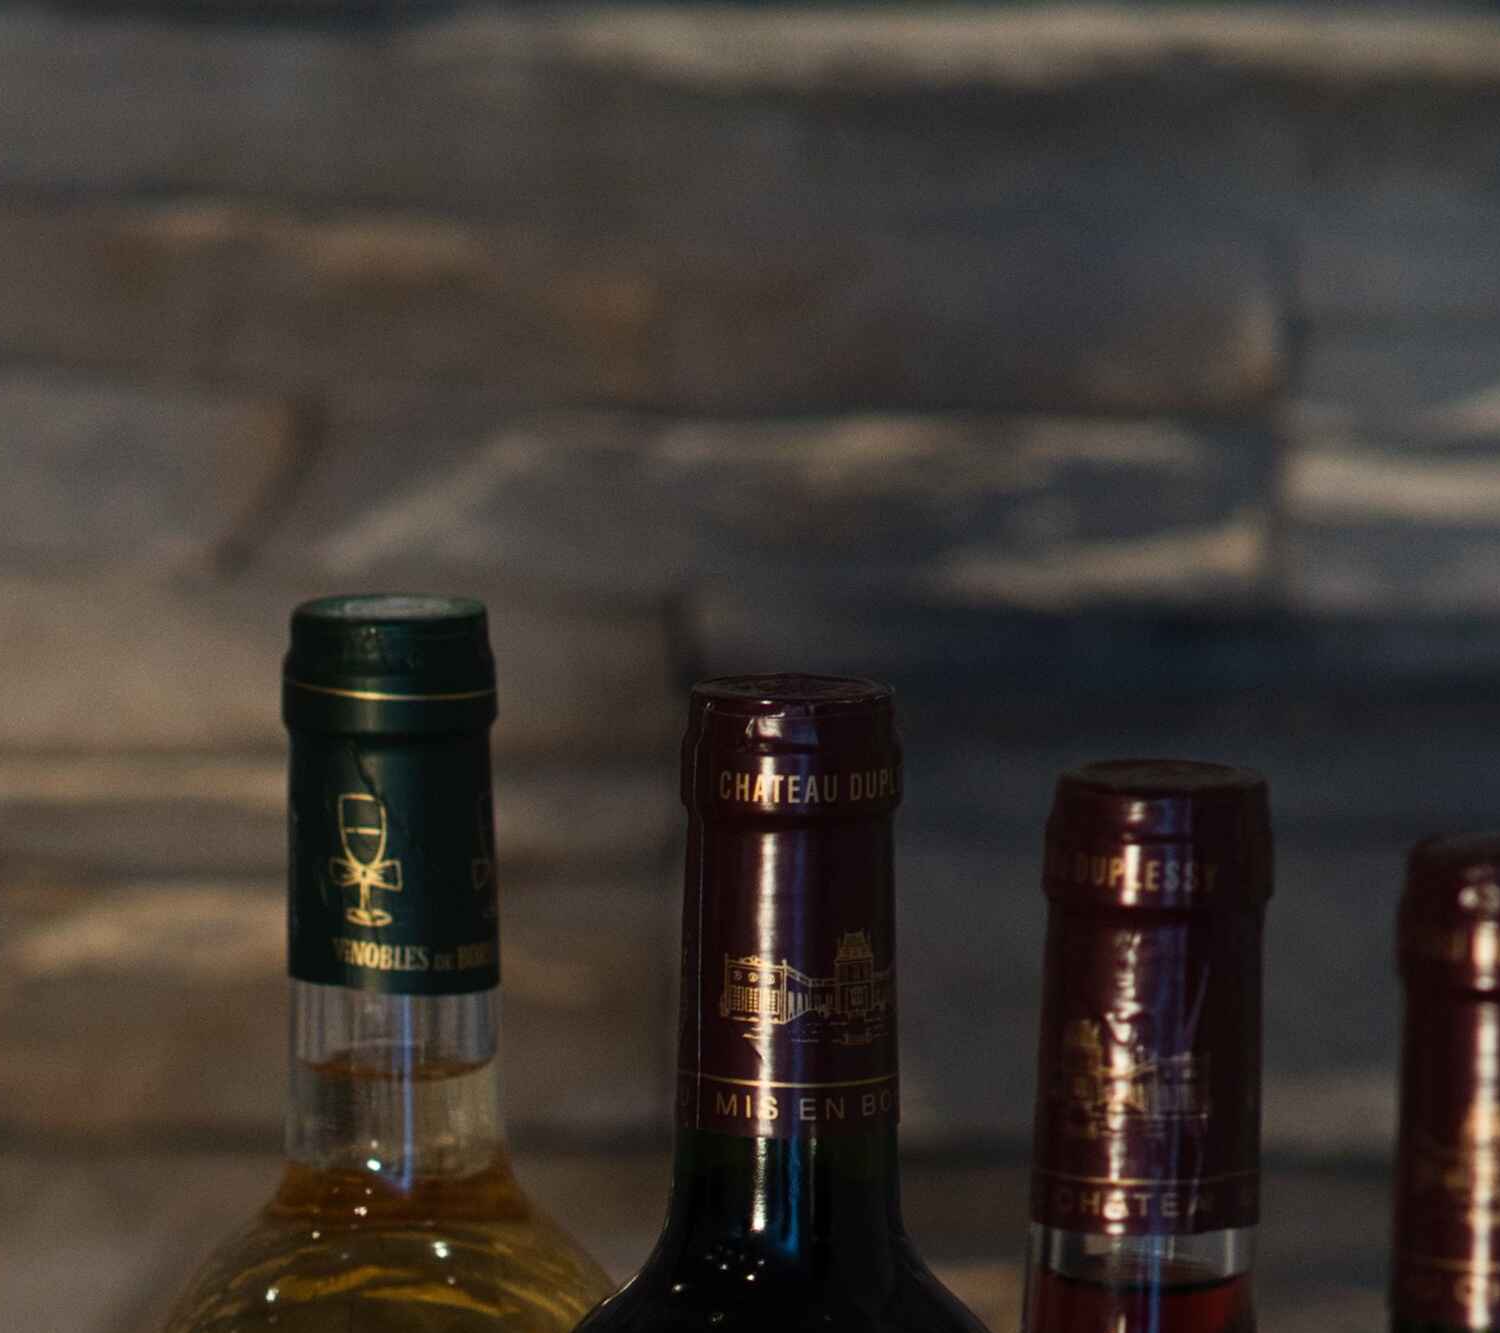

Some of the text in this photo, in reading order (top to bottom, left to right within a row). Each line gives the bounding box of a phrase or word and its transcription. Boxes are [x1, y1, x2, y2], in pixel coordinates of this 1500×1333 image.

[719, 770, 840, 805] CHATEAU
[714, 1089, 780, 1121] MIS
[799, 1096, 846, 1122] EN
